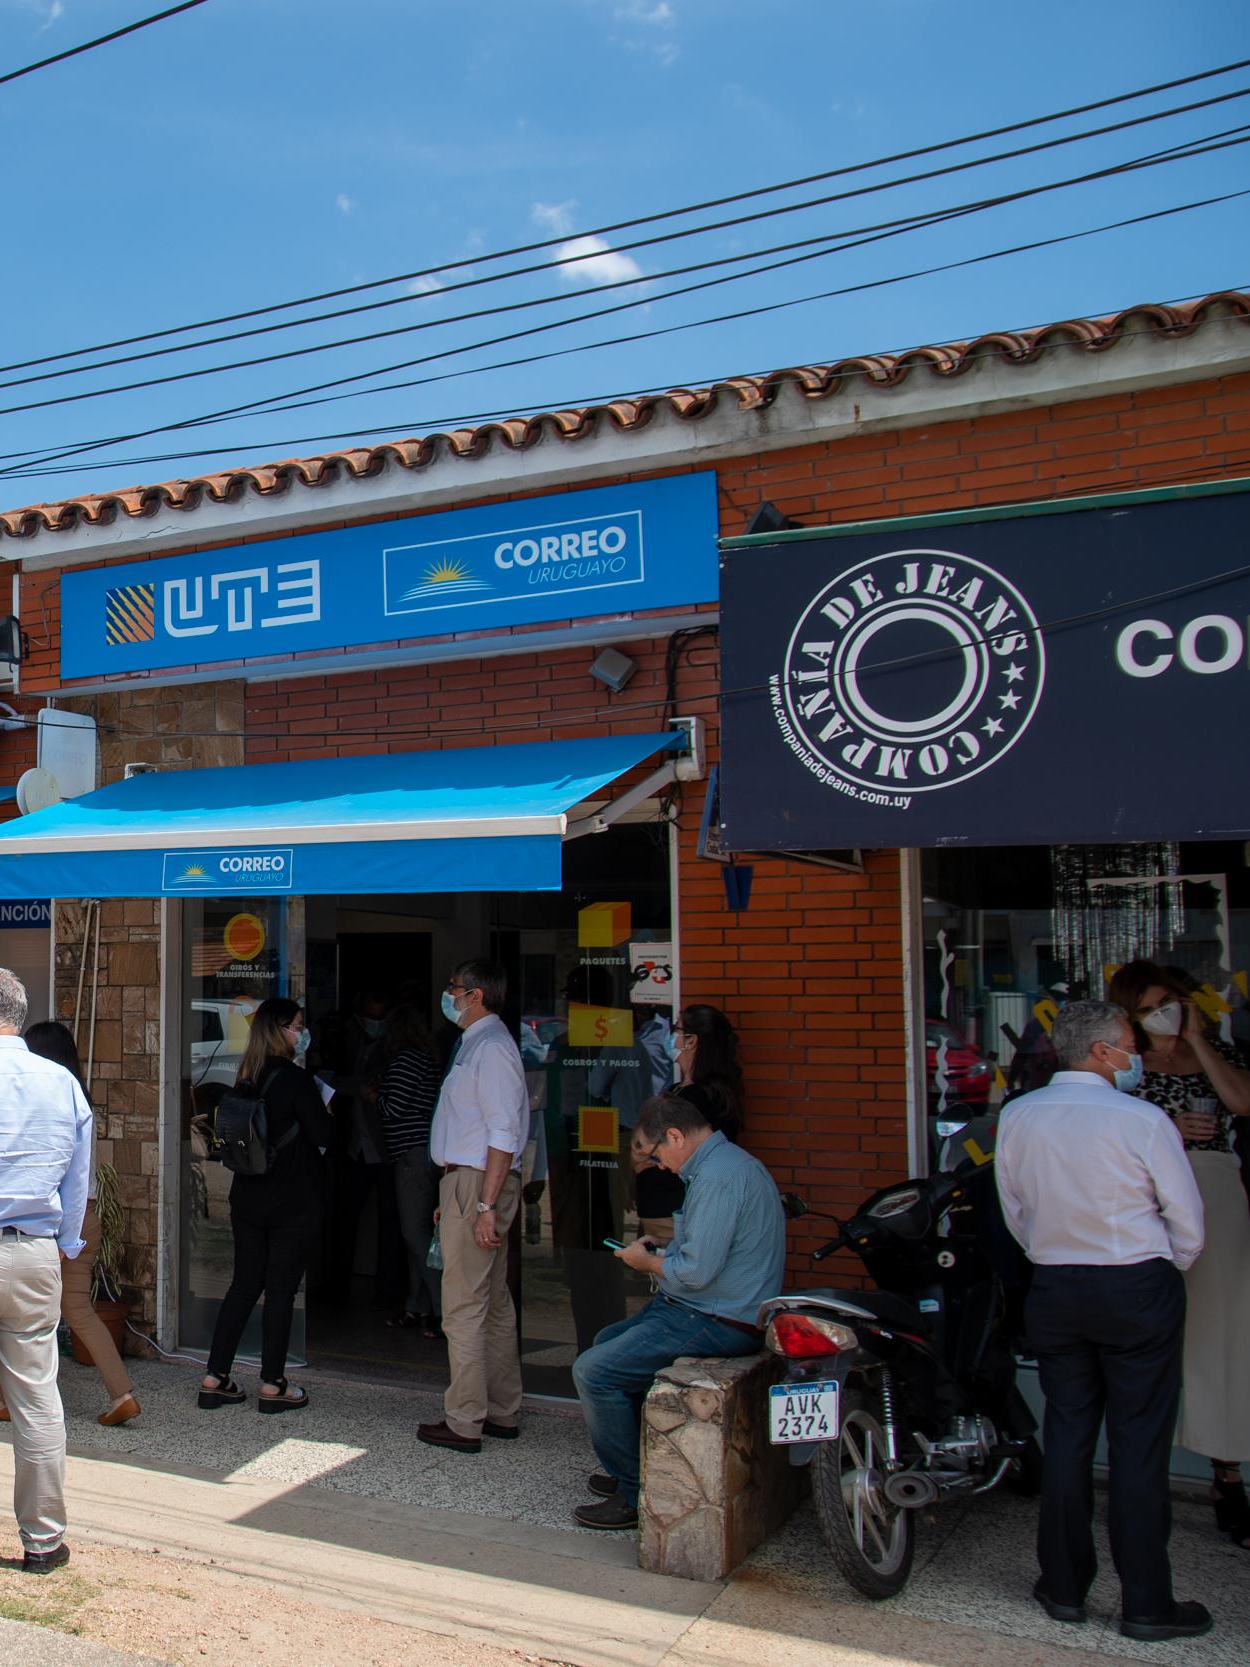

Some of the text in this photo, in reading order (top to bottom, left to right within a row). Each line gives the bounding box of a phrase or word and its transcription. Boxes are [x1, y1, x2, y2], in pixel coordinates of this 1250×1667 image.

[493, 525, 627, 571] CORREO
[526, 555, 626, 585] URUGUAYO
[163, 558, 321, 639] UTE
[819, 572, 884, 630] DE
[894, 562, 1029, 656] JEANS
[1116, 613, 1250, 678] CO
[768, 673, 912, 810] www.companiadejeans.com.uy
[219, 855, 285, 873] CORREO
[234, 872, 285, 883] URUGUAYO
[229, 963, 261, 972] GIROS Y
[579, 957, 627, 966] PAQUETES
[215, 970, 275, 979] TRANSFERENCIAS
[562, 1058, 641, 1068] COBROS Y PAGOS
[579, 1159, 619, 1169] FILATELIA
[784, 1394, 822, 1416] AVK
[778, 1414, 829, 1438] 2374
